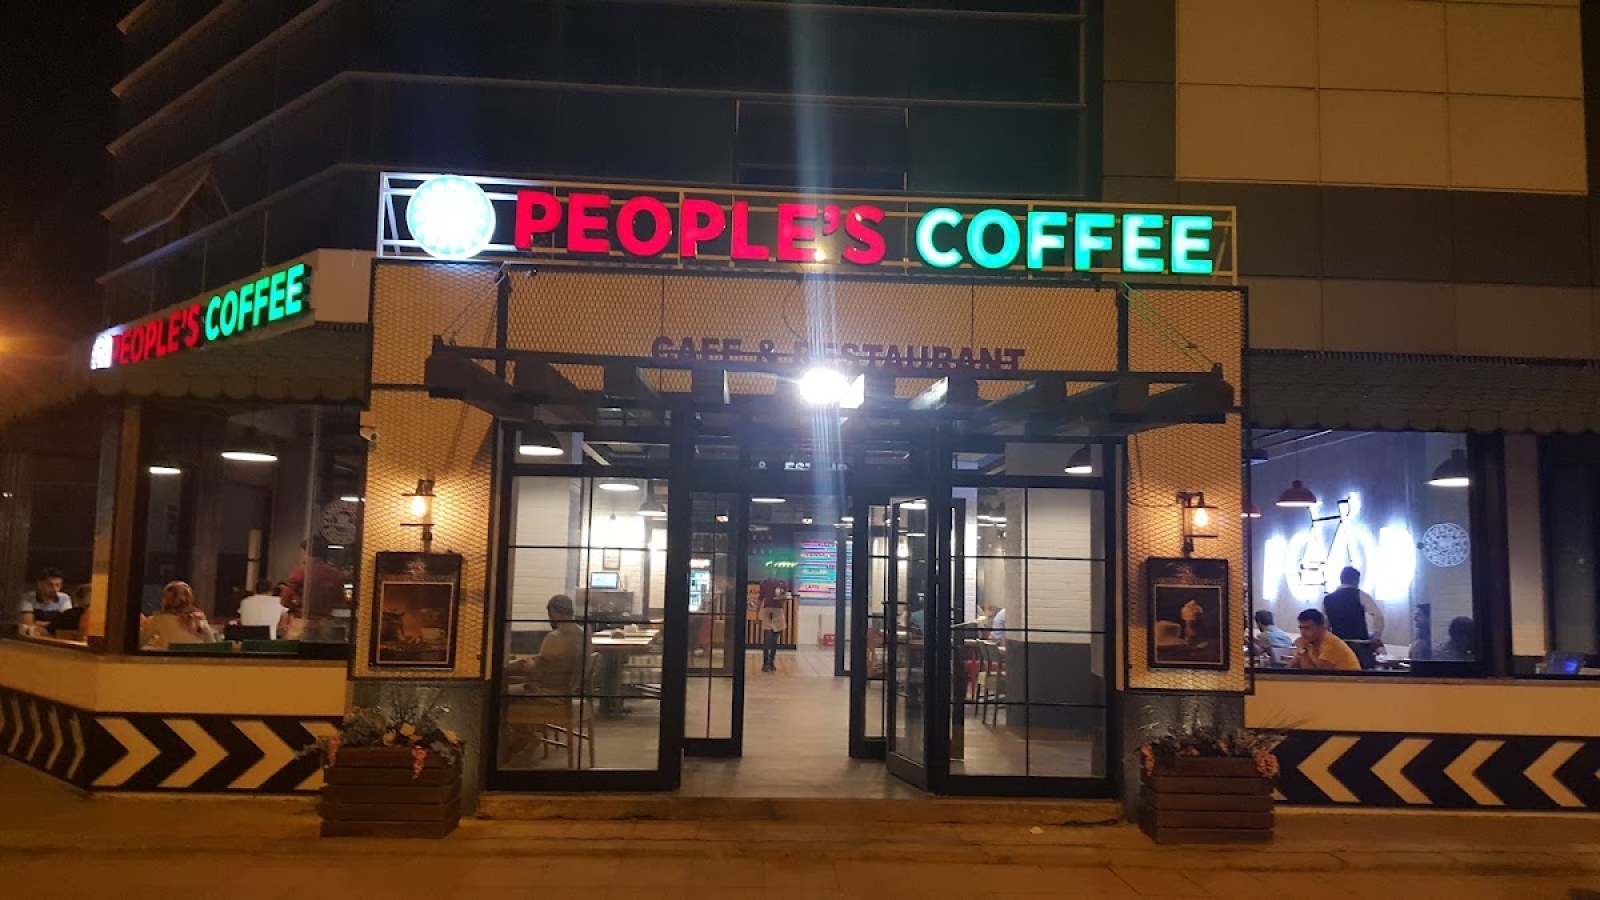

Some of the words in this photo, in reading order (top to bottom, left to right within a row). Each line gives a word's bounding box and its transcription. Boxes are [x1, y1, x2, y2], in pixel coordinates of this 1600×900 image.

[515, 189, 886, 265] PEOPLE'S
[915, 207, 1213, 274] COFFEE
[112, 304, 200, 365] PEOPLE'S
[204, 263, 304, 341] COFFEE
[652, 336, 742, 362] CAFE
[757, 340, 775, 363] &
